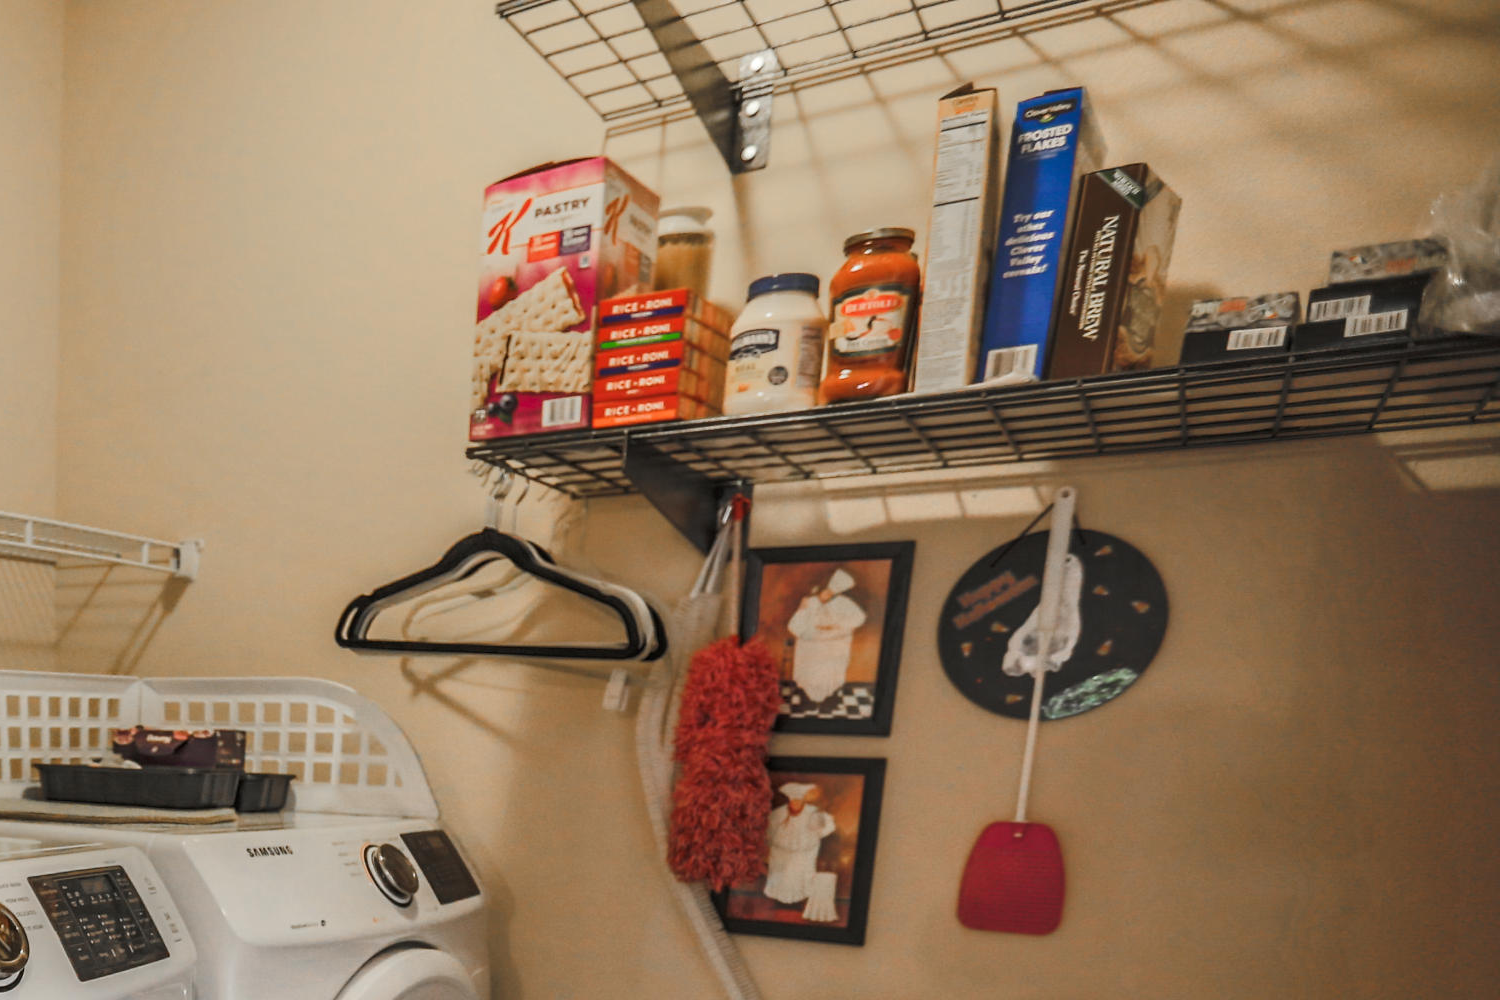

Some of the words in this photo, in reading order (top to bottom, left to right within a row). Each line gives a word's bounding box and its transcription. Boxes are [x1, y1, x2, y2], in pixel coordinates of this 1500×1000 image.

[1018, 124, 1073, 144] FROSTED
[1021, 136, 1067, 154] FLAKES
[534, 197, 590, 218] PASTRY
[1090, 214, 1121, 291] NATURAL
[1081, 291, 1106, 342] BREW
[246, 844, 293, 858] SAMSUNG
